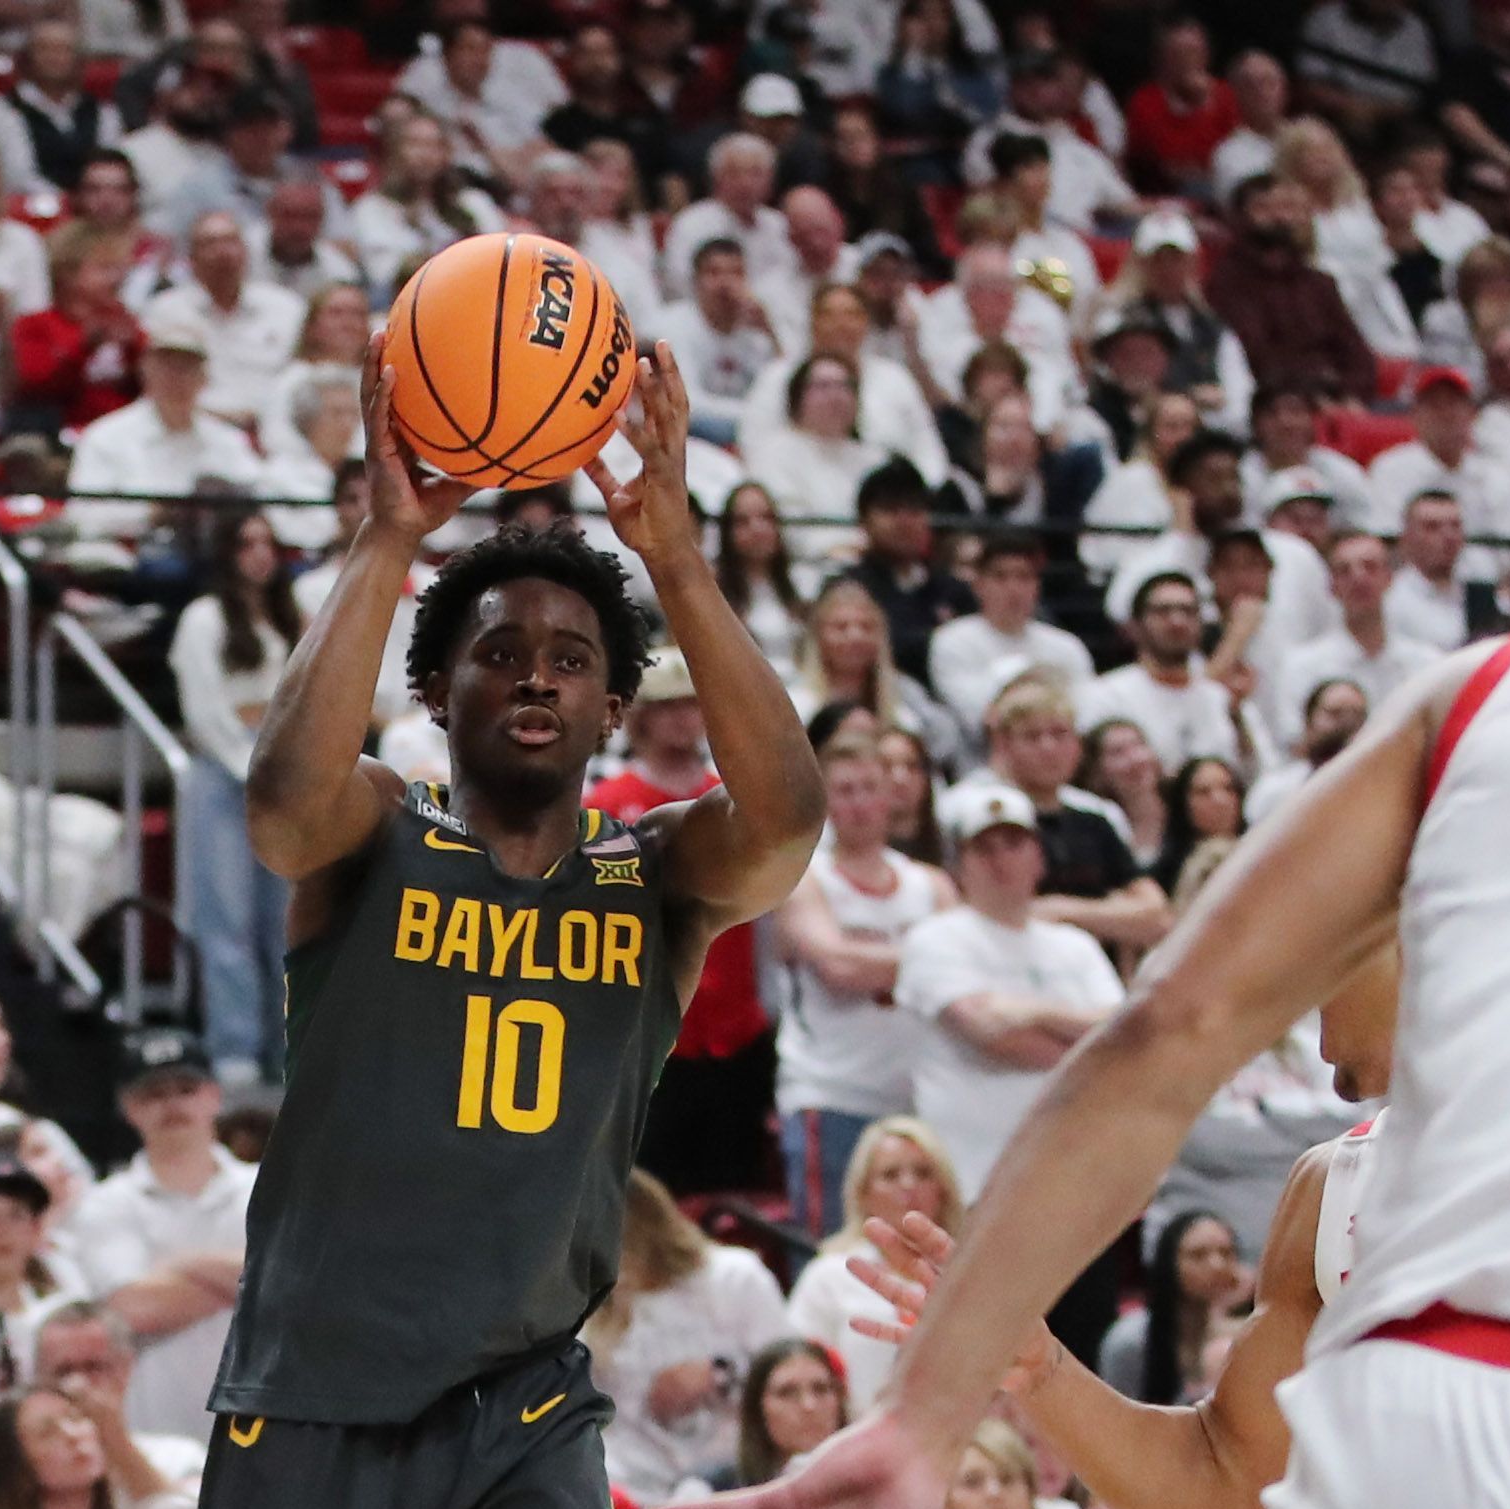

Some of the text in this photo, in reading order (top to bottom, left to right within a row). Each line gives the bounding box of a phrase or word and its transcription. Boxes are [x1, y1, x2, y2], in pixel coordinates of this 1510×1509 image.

[528, 250, 575, 350] NCAA
[394, 887, 644, 988] BAYLOR
[457, 994, 566, 1135] 10
